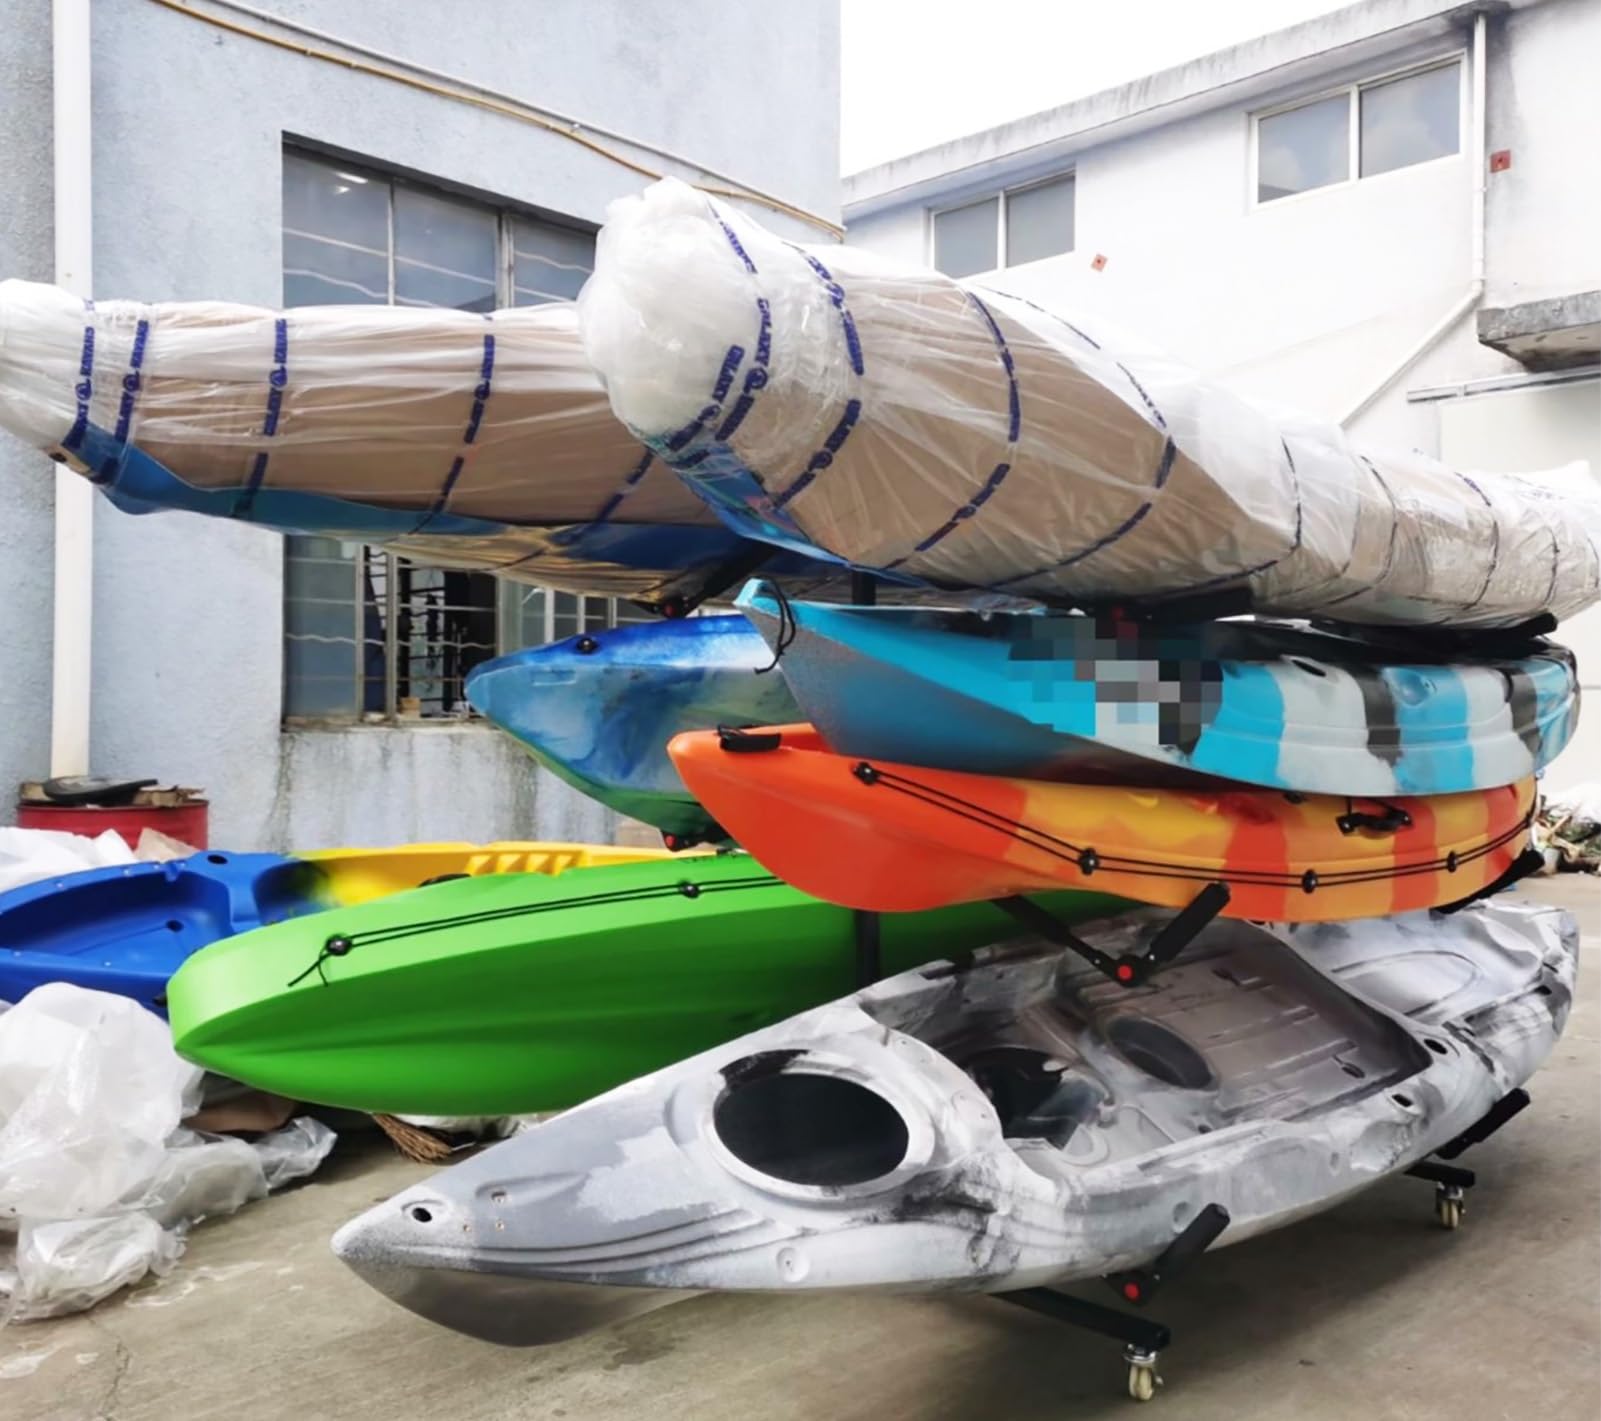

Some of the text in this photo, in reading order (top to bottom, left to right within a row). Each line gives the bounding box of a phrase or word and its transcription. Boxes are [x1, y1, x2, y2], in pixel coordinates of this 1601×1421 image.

[79, 326, 95, 377] KAYAKS
[756, 297, 772, 367] GALAXY
[712, 345, 745, 402] GALAXY
